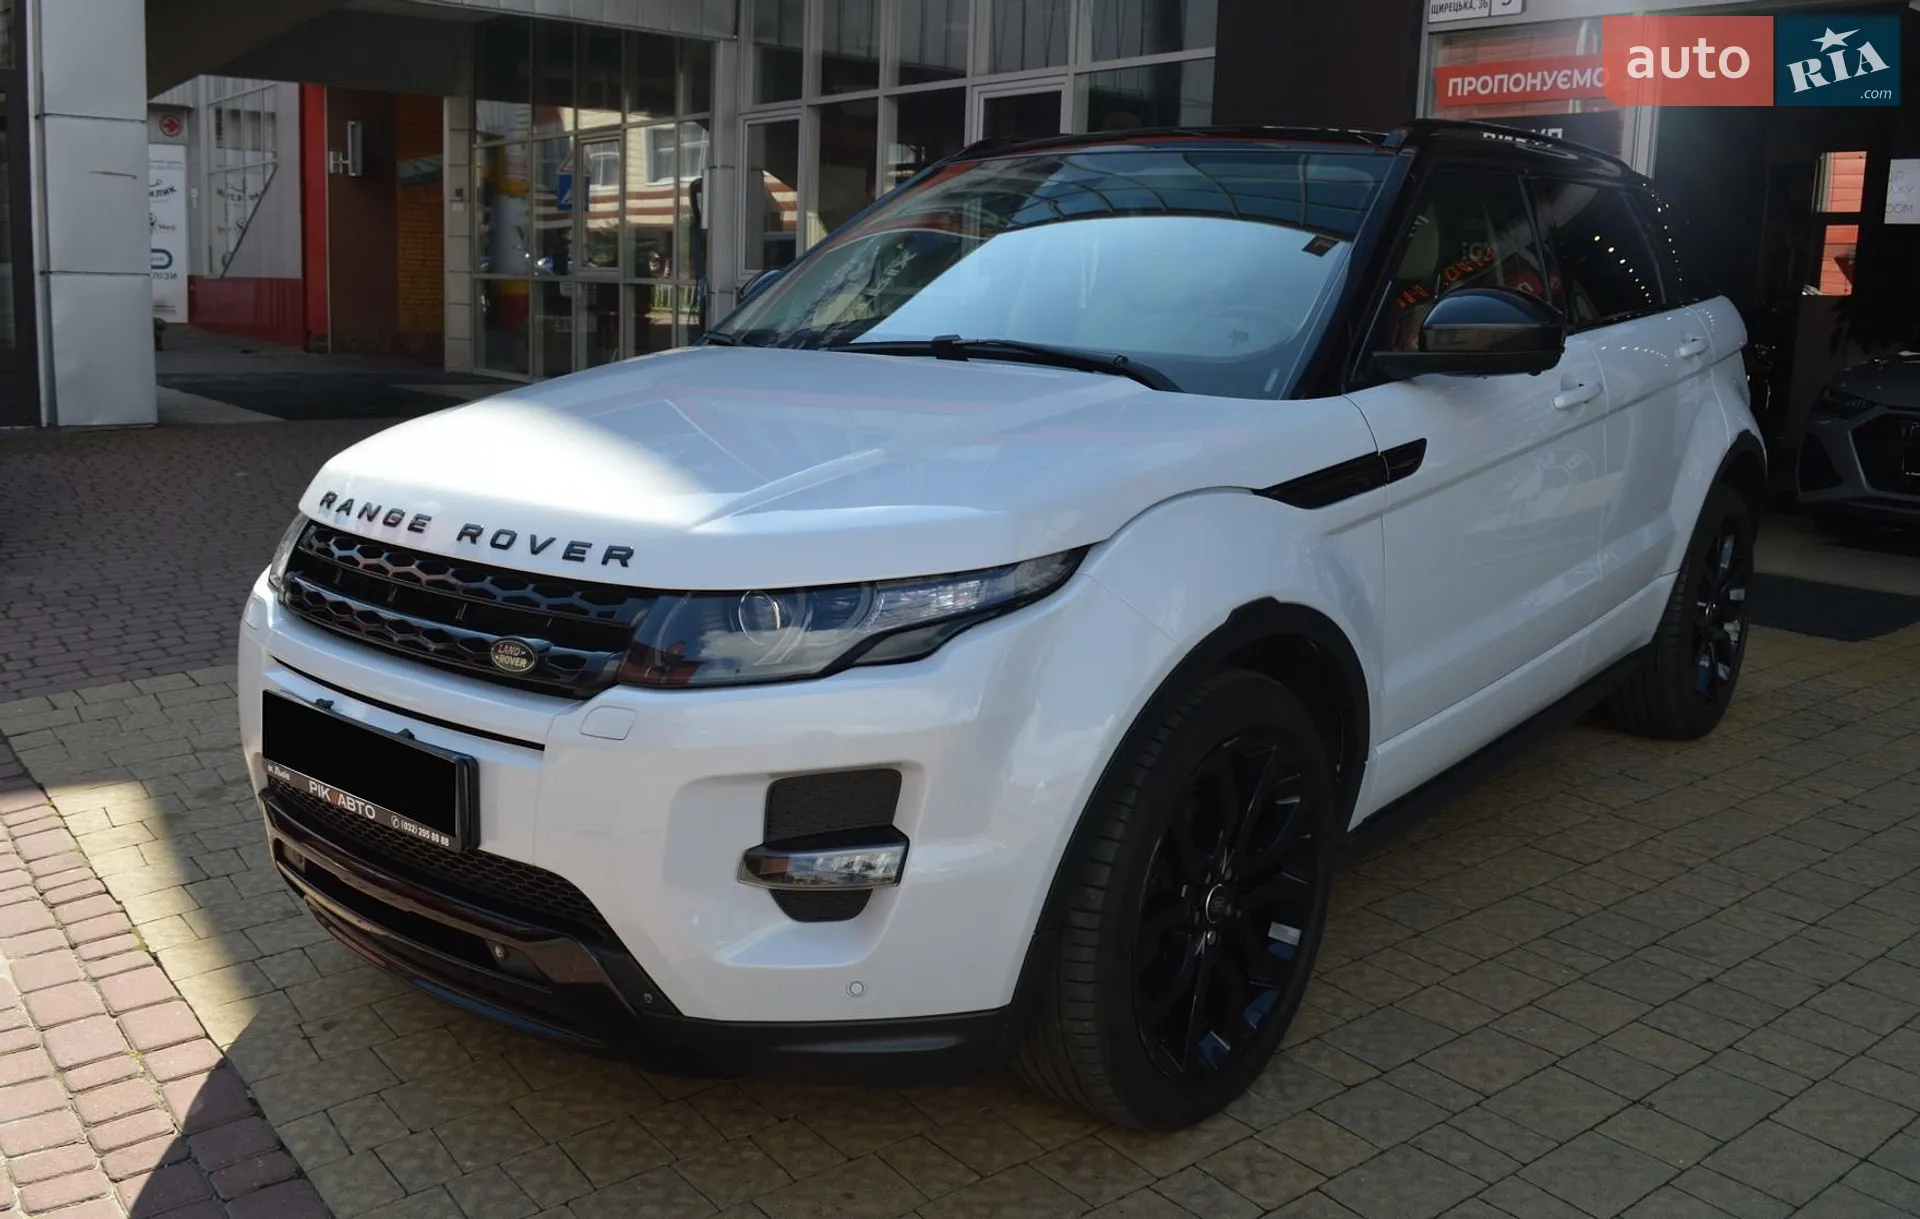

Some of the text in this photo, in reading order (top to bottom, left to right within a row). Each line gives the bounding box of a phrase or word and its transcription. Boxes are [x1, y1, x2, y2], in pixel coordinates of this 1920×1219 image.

[1431, 1, 1476, 15] ЩИРЕЦЬКА,
[319, 491, 635, 568] RANGE ROVER
[498, 644, 520, 656] LAND
[499, 654, 528, 668] ROVER
[401, 820, 418, 835] (032)
